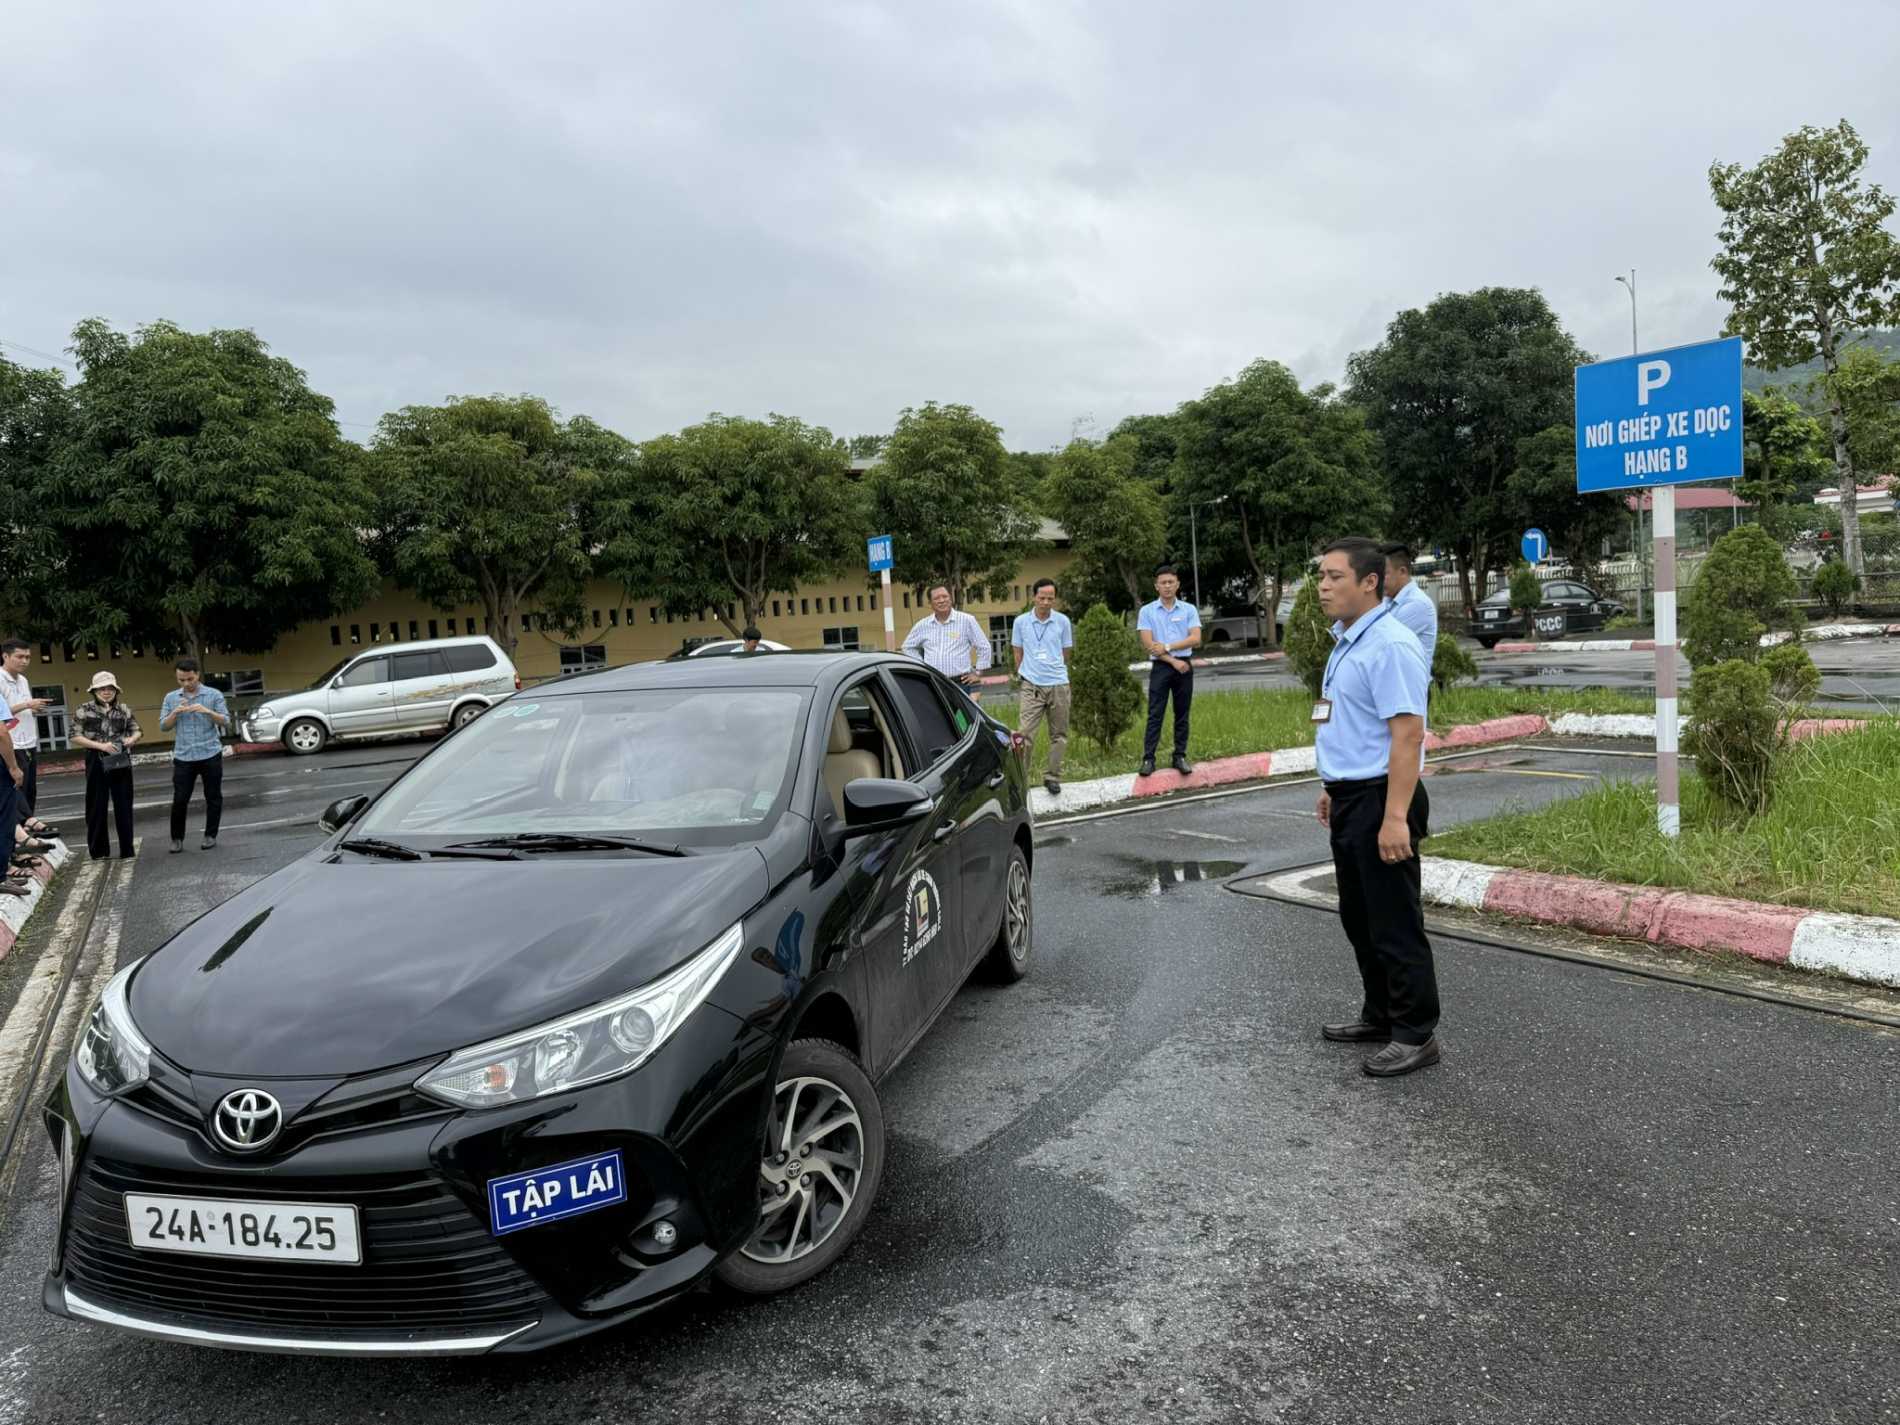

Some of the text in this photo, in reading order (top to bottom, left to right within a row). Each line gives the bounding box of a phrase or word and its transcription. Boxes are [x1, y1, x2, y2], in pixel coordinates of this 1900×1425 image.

[1637, 359, 1672, 406] P
[1585, 404, 1731, 449] NƠI GHÉP XE DỌC
[1624, 445, 1688, 479] HẠNG B
[502, 1163, 614, 1218] TẬP LÁI
[146, 1206, 336, 1251] 24A-184.25
